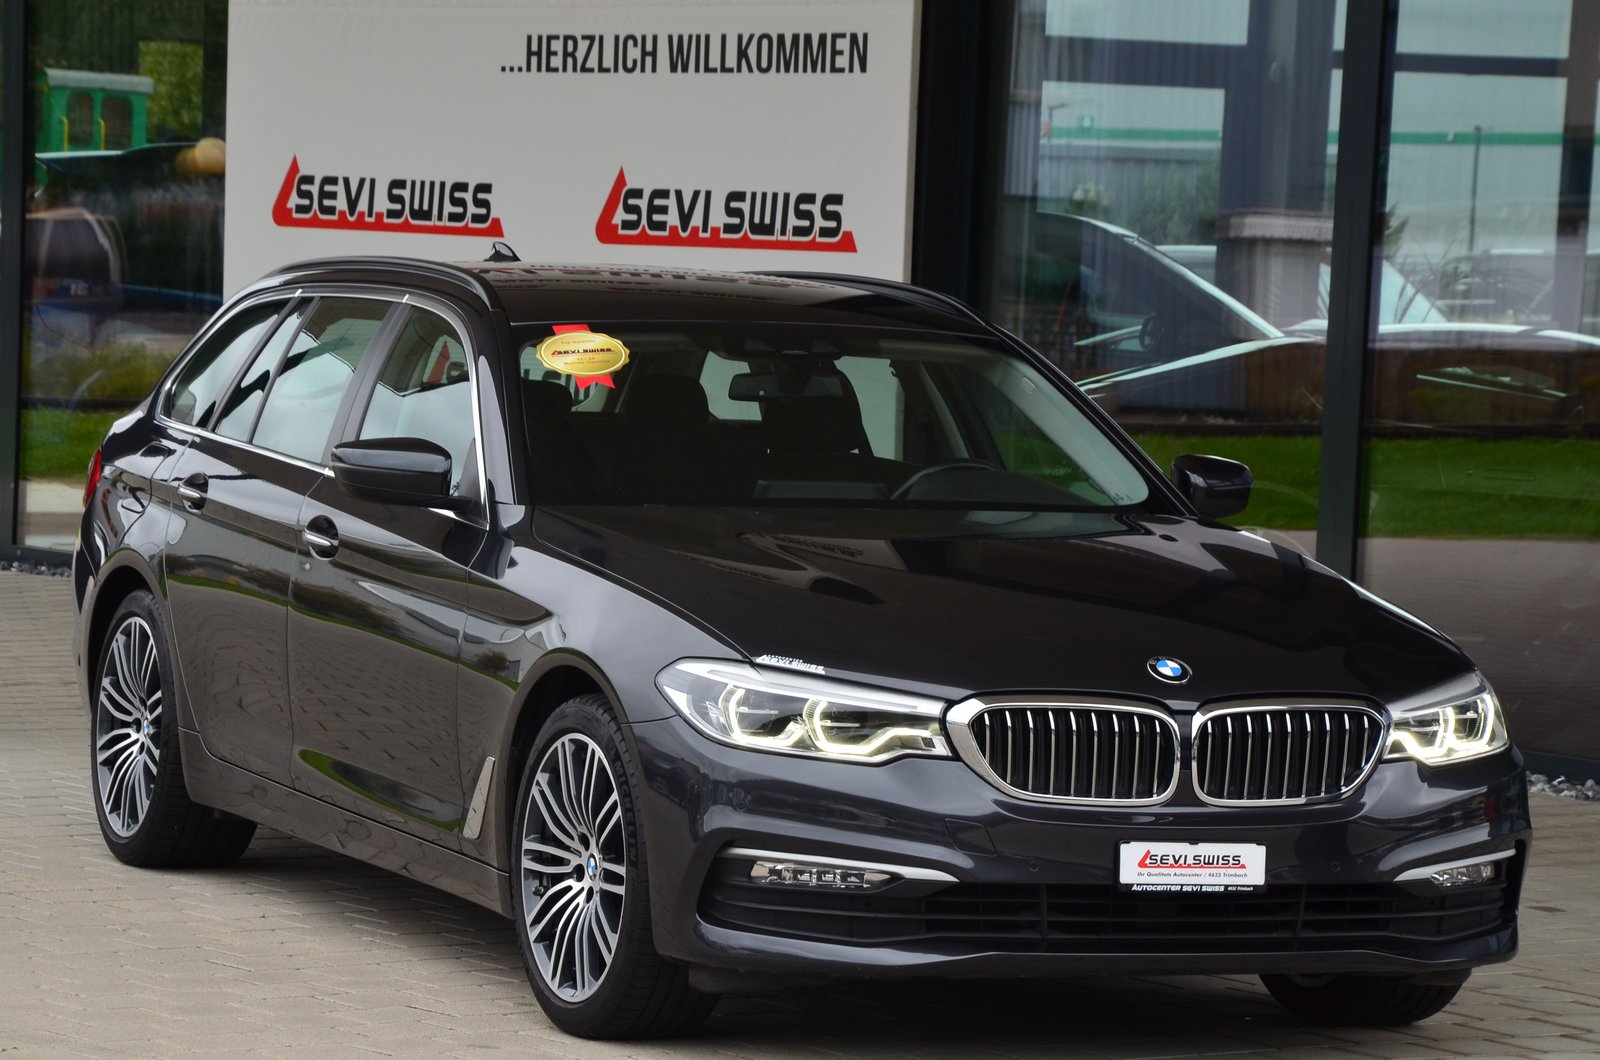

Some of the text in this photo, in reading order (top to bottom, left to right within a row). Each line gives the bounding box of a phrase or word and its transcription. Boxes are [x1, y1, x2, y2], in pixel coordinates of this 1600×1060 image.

[501, 32, 869, 74] ...HERZLICH WILLKOMMEN
[294, 174, 493, 225] SEVI SWISS
[620, 187, 844, 239] SEVI SWISS
[613, 761, 638, 863] MICHELIN
[1148, 854, 1241, 866] SEVI SWISS
[1131, 883, 1182, 891] AUTOCENTER
